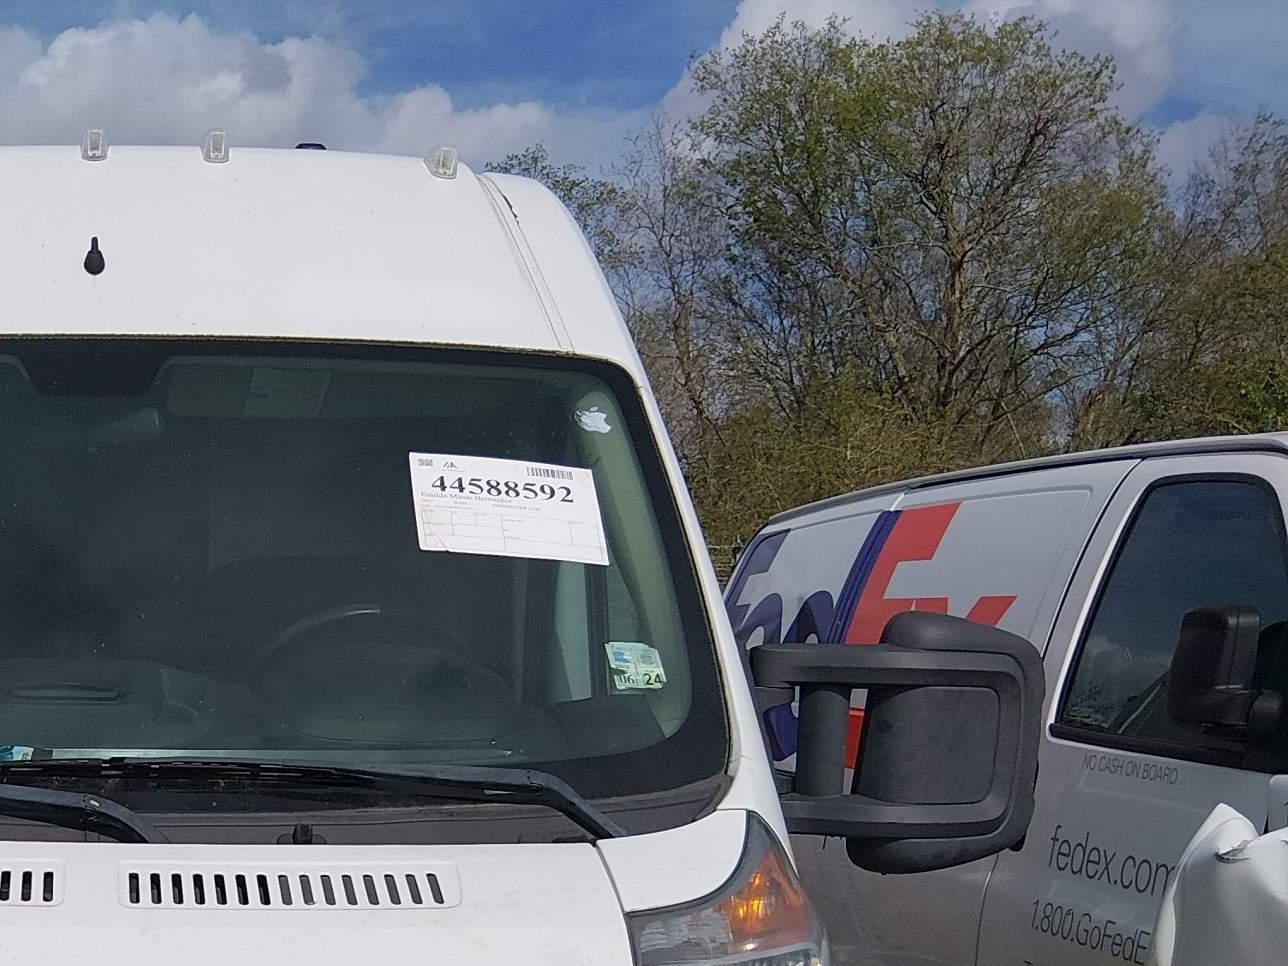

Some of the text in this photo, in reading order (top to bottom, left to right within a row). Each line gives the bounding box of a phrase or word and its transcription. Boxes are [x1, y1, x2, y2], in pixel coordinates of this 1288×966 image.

[431, 475, 574, 503] 44588592
[643, 672, 664, 686] 24
[1082, 754, 1179, 784] NO CASH ON BOARD
[1048, 824, 1175, 896] fedex.com
[1031, 899, 1151, 966] 1.800.GoFedE
